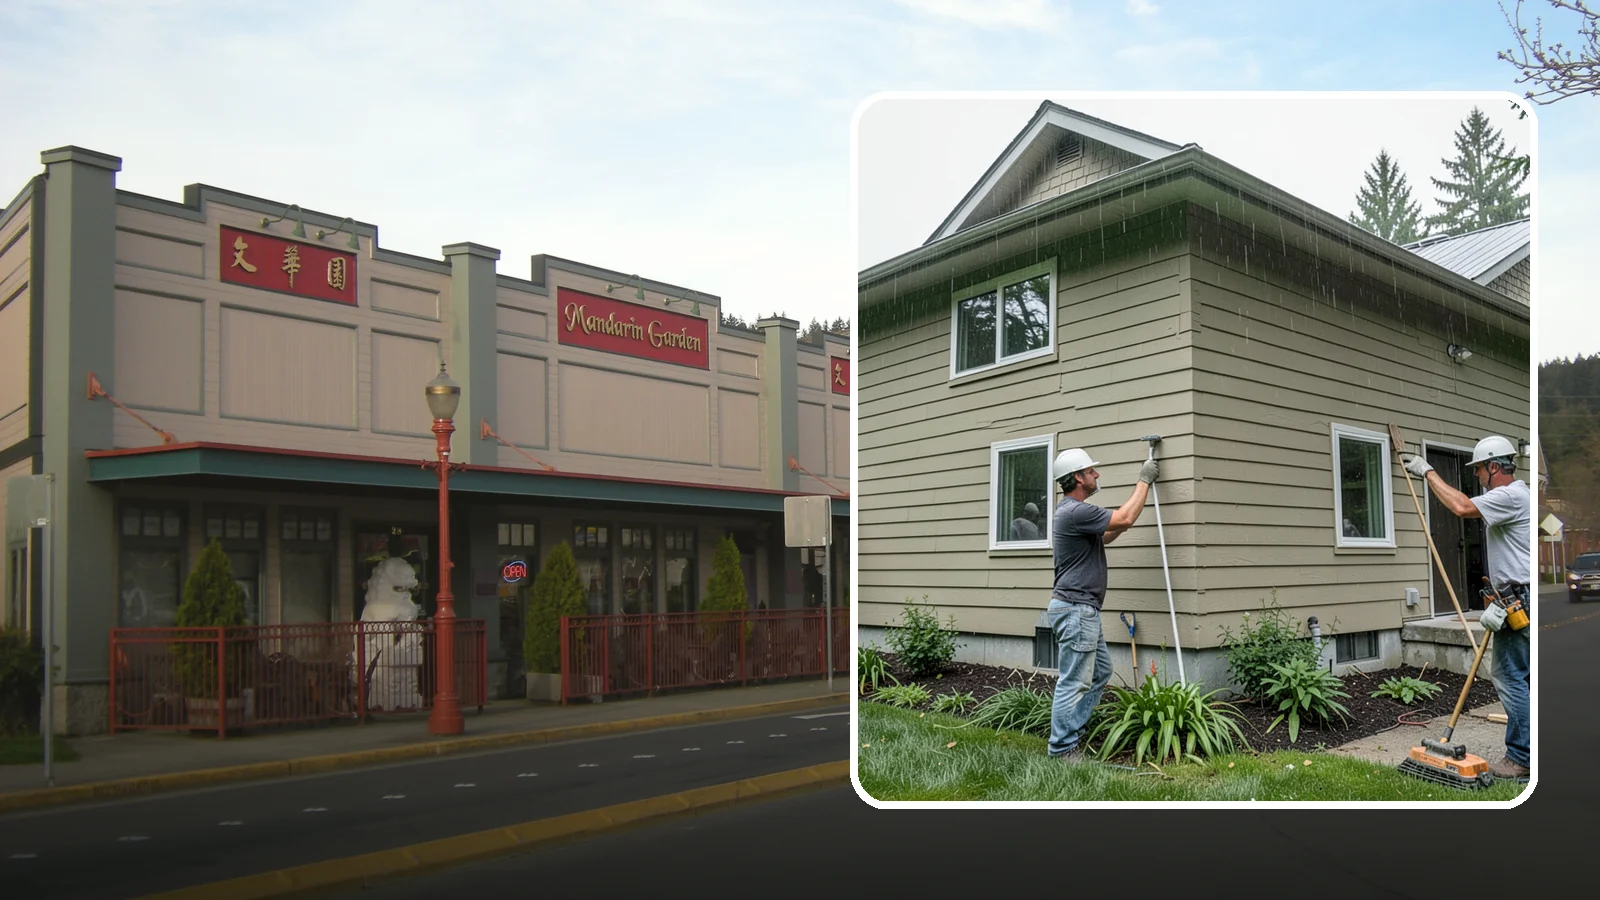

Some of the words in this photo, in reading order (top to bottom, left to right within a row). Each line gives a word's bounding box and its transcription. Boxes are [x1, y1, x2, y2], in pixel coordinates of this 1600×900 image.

[231, 235, 346, 291] 文華園
[564, 302, 644, 341] Mandarin
[647, 320, 702, 352] Garden
[503, 565, 527, 578] OPEN
